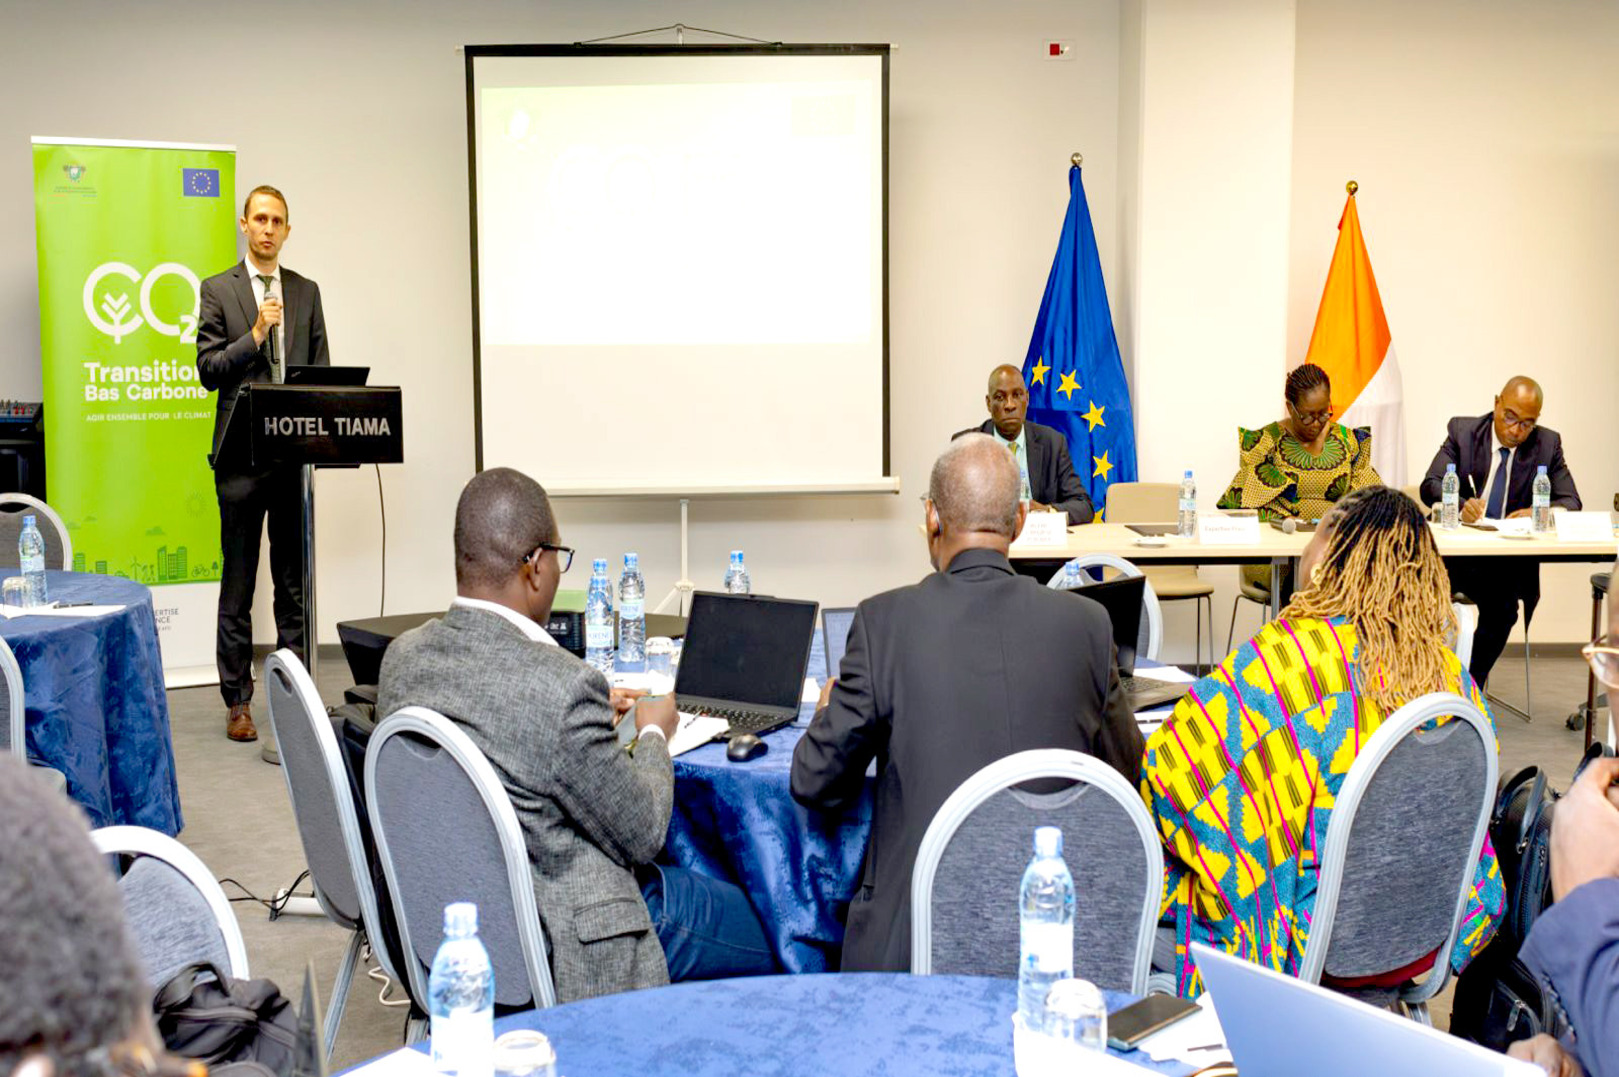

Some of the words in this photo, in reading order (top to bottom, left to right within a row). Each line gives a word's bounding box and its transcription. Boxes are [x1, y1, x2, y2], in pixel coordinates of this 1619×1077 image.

[84, 384, 119, 402] Bas
[126, 383, 208, 401] Carbone
[106, 413, 146, 421] ENSEMBLE
[148, 412, 170, 420] POUR
[184, 411, 212, 419] CLIMAT
[264, 417, 329, 436] HOTEL
[334, 417, 391, 436] TIAMA
